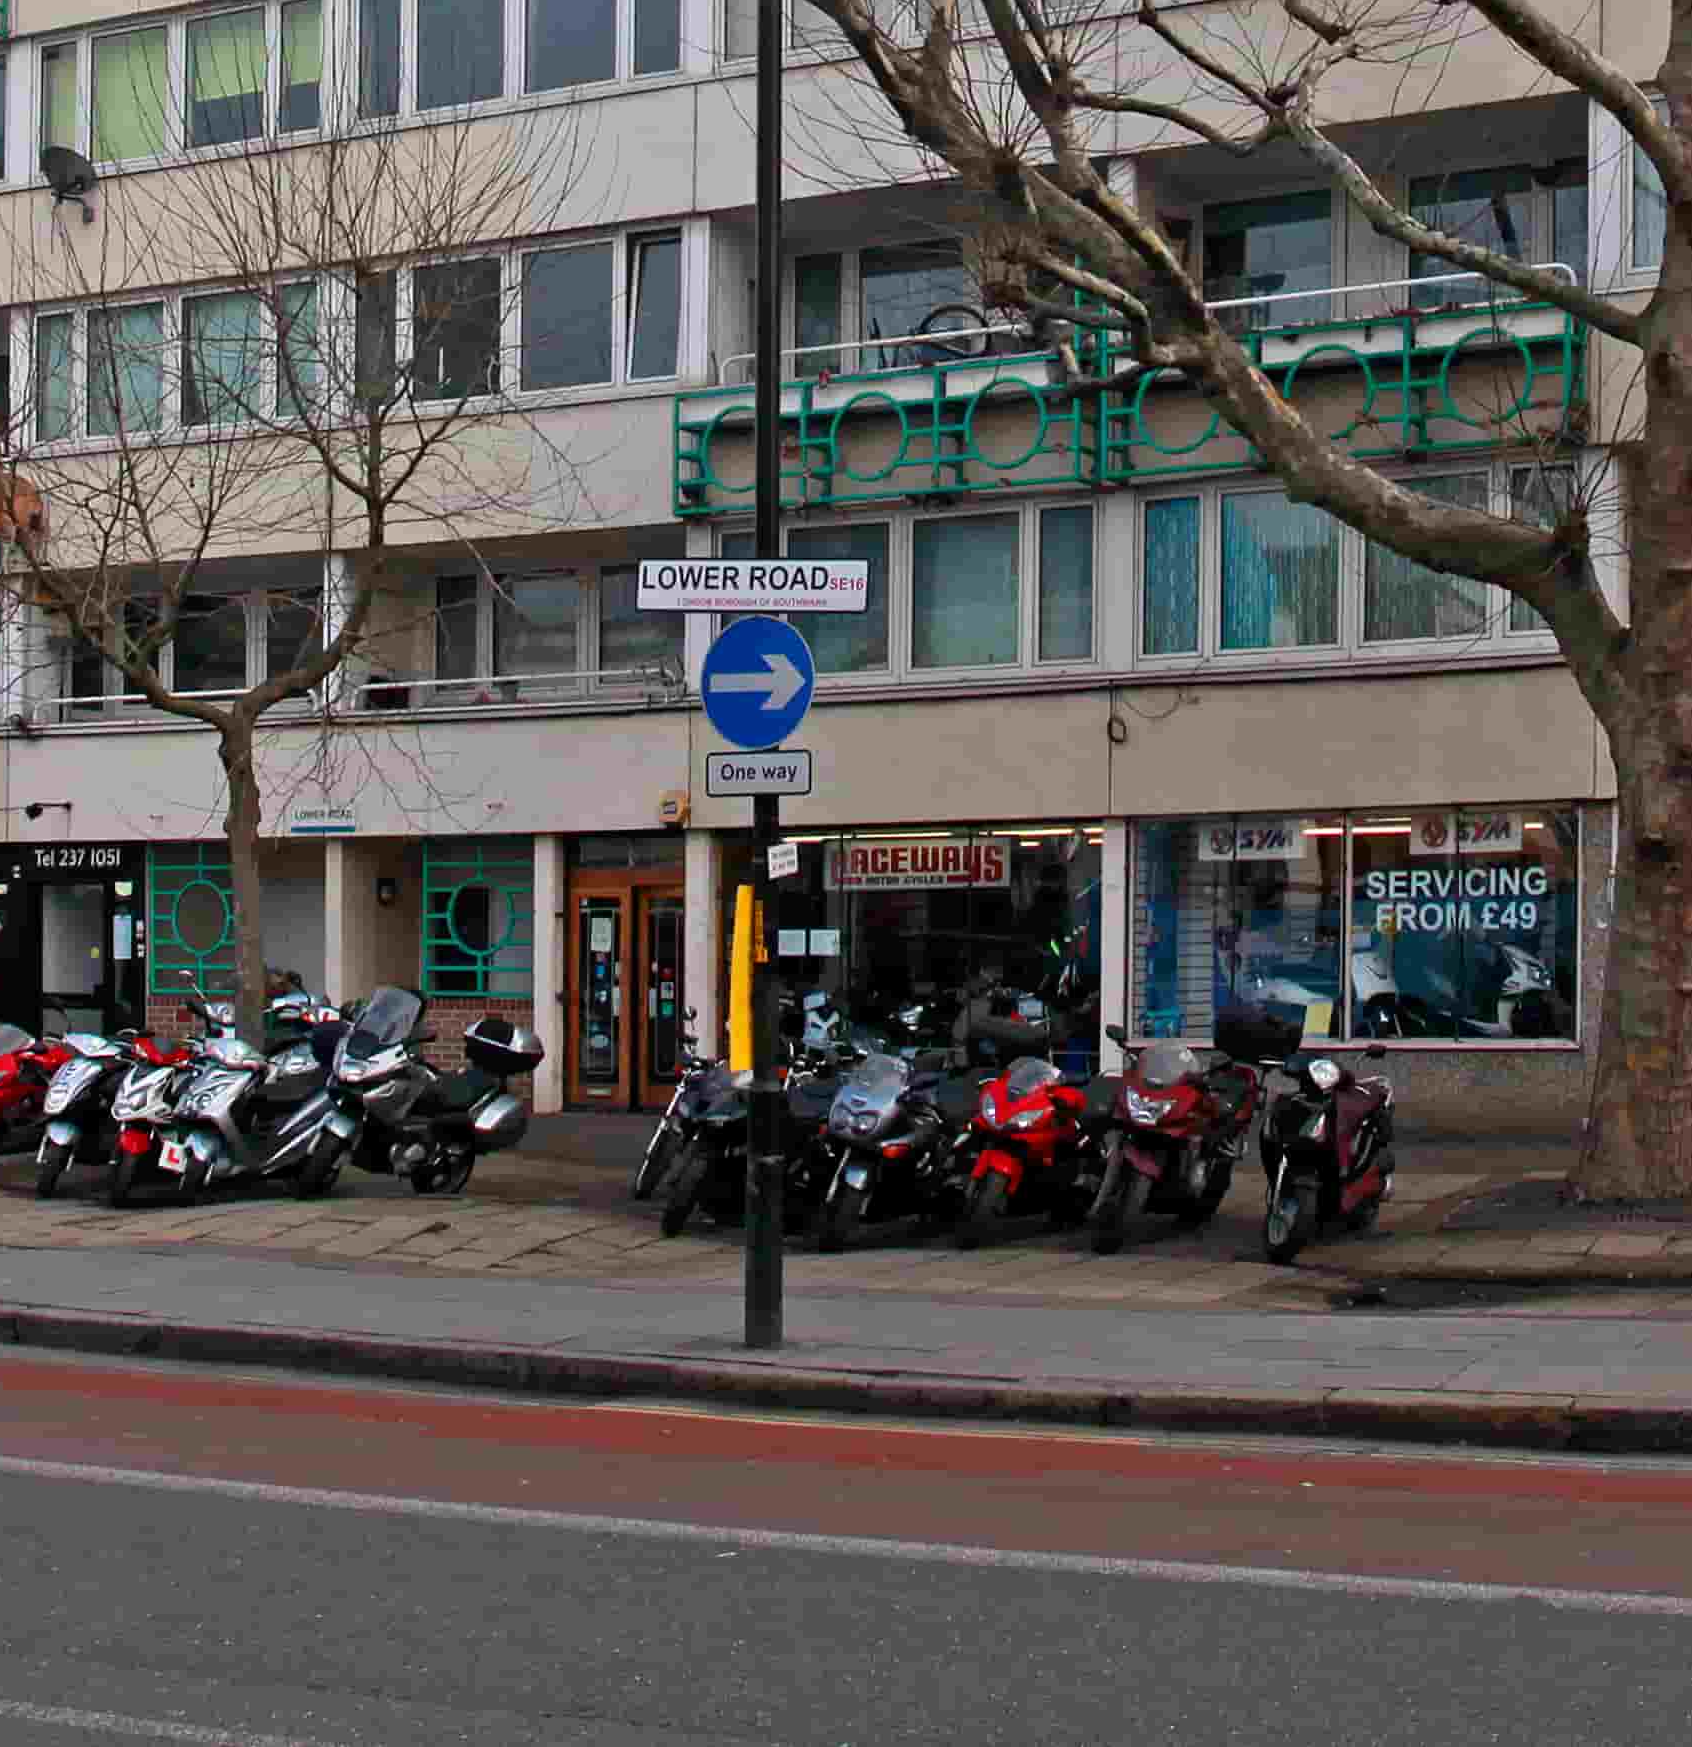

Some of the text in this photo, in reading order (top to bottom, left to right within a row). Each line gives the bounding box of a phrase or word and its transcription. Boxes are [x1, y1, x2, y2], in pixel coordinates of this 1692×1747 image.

[642, 565, 865, 591] LOWER ROAD SE16
[720, 764, 797, 782] One way
[1239, 828, 1293, 851] SYM
[34, 848, 55, 867] Tel
[58, 848, 86, 867] 237
[90, 848, 121, 867] 1051
[1366, 867, 1548, 899] SERVICING
[1376, 901, 1538, 932] FROM £49
[168, 1148, 180, 1165] L
